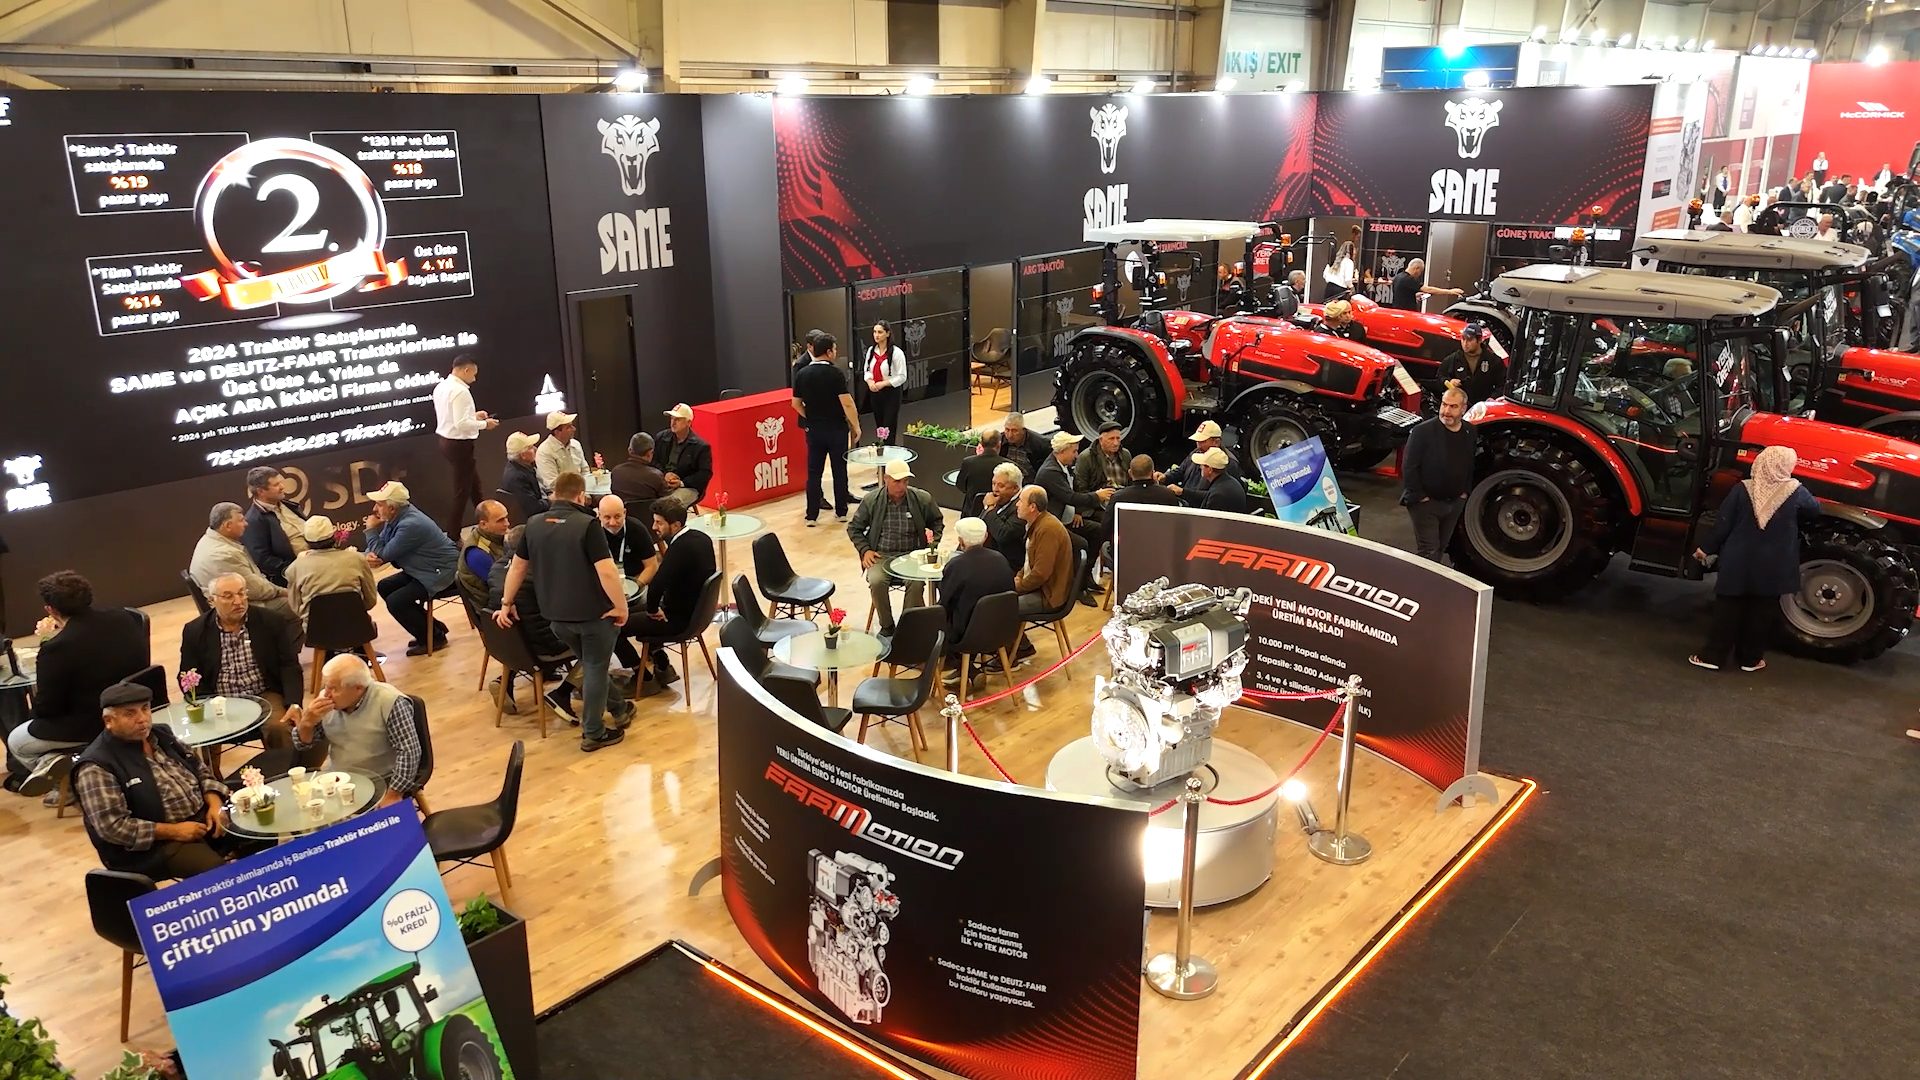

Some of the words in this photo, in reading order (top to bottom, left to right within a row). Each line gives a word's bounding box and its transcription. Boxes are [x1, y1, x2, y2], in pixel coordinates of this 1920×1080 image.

[127, 143, 177, 156] Traktör
[357, 150, 396, 161] traktör
[84, 159, 165, 174] satışlarında
[393, 163, 423, 176] %18
[110, 175, 149, 189] %19
[384, 179, 413, 192] pazar
[98, 194, 137, 208] pazar
[1429, 168, 1500, 216] SAME
[1083, 184, 1129, 242] SAME
[1369, 223, 1403, 233] ZEKERYA
[1404, 224, 1423, 235] KOÇ
[1496, 228, 1528, 240] GÜNEŞ
[597, 207, 674, 275] SAME
[133, 262, 182, 277] Traktör
[421, 260, 435, 271] 4.
[101, 278, 182, 296] Satışlarında
[878, 283, 913, 298] TRAKTÖR
[124, 295, 162, 310] %14
[111, 314, 150, 329] pazar
[188, 344, 238, 363] 2024
[239, 335, 311, 356] Traktör
[314, 323, 418, 349] Satışlarında
[110, 369, 177, 394] SAME
[180, 370, 206, 385] ve
[209, 351, 338, 381] DEUTZ-FAHR
[339, 334, 455, 362] Traktörlerimiz
[457, 331, 478, 347] ile
[221, 379, 259, 398] Üst
[260, 374, 305, 393] Üste
[308, 370, 326, 387] 4.
[328, 362, 374, 382] Yılda
[377, 359, 400, 376] da
[175, 402, 229, 425] AÇIK
[232, 395, 278, 416] ARA
[279, 383, 339, 408] İKİNCİ
[341, 378, 393, 399] Firma
[178, 432, 200, 442] 2024
[240, 420, 269, 432] traktör
[270, 414, 309, 427] verilerine
[310, 411, 329, 423] göre
[330, 405, 362, 419] yaklaşık
[753, 456, 789, 492] SAME
[1272, 607, 1304, 626] ÜRETİM
[1306, 618, 1344, 638] BAŞLADI
[1275, 598, 1297, 612] YENİ
[1298, 604, 1332, 622] MOTOR
[1333, 614, 1398, 647] FABRİKAMIZDA
[1258, 636, 1283, 649] 10.000
[1295, 646, 1319, 659] kapalı
[1320, 653, 1347, 669] alanda
[1257, 653, 1293, 670] Kapasite:
[1293, 663, 1318, 677] 30.000
[1318, 671, 1337, 686] Adet
[1256, 682, 1279, 694] motor
[1264, 674, 1271, 682] 4
[1271, 676, 1281, 685] ve
[1282, 678, 1288, 686] 6
[797, 747, 835, 773] Türkiye'deki
[835, 766, 852, 780] Yeni
[852, 773, 905, 800] Fabrikamızda
[811, 765, 830, 781] EURO
[830, 776, 836, 784] 5
[836, 778, 863, 796] MOTOR
[863, 788, 901, 810] Üretimine
[901, 802, 940, 822] Başladık.
[145, 899, 179, 918] Deutz
[178, 889, 203, 906] Fahr
[203, 875, 236, 897] traktör
[236, 858, 284, 885] alımlarında
[292, 844, 326, 863] Bankası
[324, 831, 358, 850] Traktör
[357, 819, 390, 838] Kredisi
[388, 815, 401, 827] ile
[152, 907, 220, 943] Benim
[220, 875, 299, 916] Bankam
[387, 915, 405, 927] %0
[404, 901, 434, 921] FAİZLİ
[161, 917, 257, 971] çiftçinin
[254, 876, 350, 933] yanında!
[400, 917, 428, 936] KREDİ
[967, 920, 998, 934] Sadece
[998, 927, 1020, 939] tarım
[960, 935, 972, 946] İLK
[973, 941, 984, 949] ve
[984, 942, 998, 953] TEK
[998, 946, 1029, 959] MOTOR
[978, 932, 1023, 950] tasarlanmış
[937, 957, 966, 973] Sadece
[966, 966, 989, 980] SAME
[989, 974, 1000, 982] ve
[1000, 975, 1048, 993] DEUTZ-FAHR
[948, 979, 959, 989] bu
[956, 972, 981, 986] traktör
